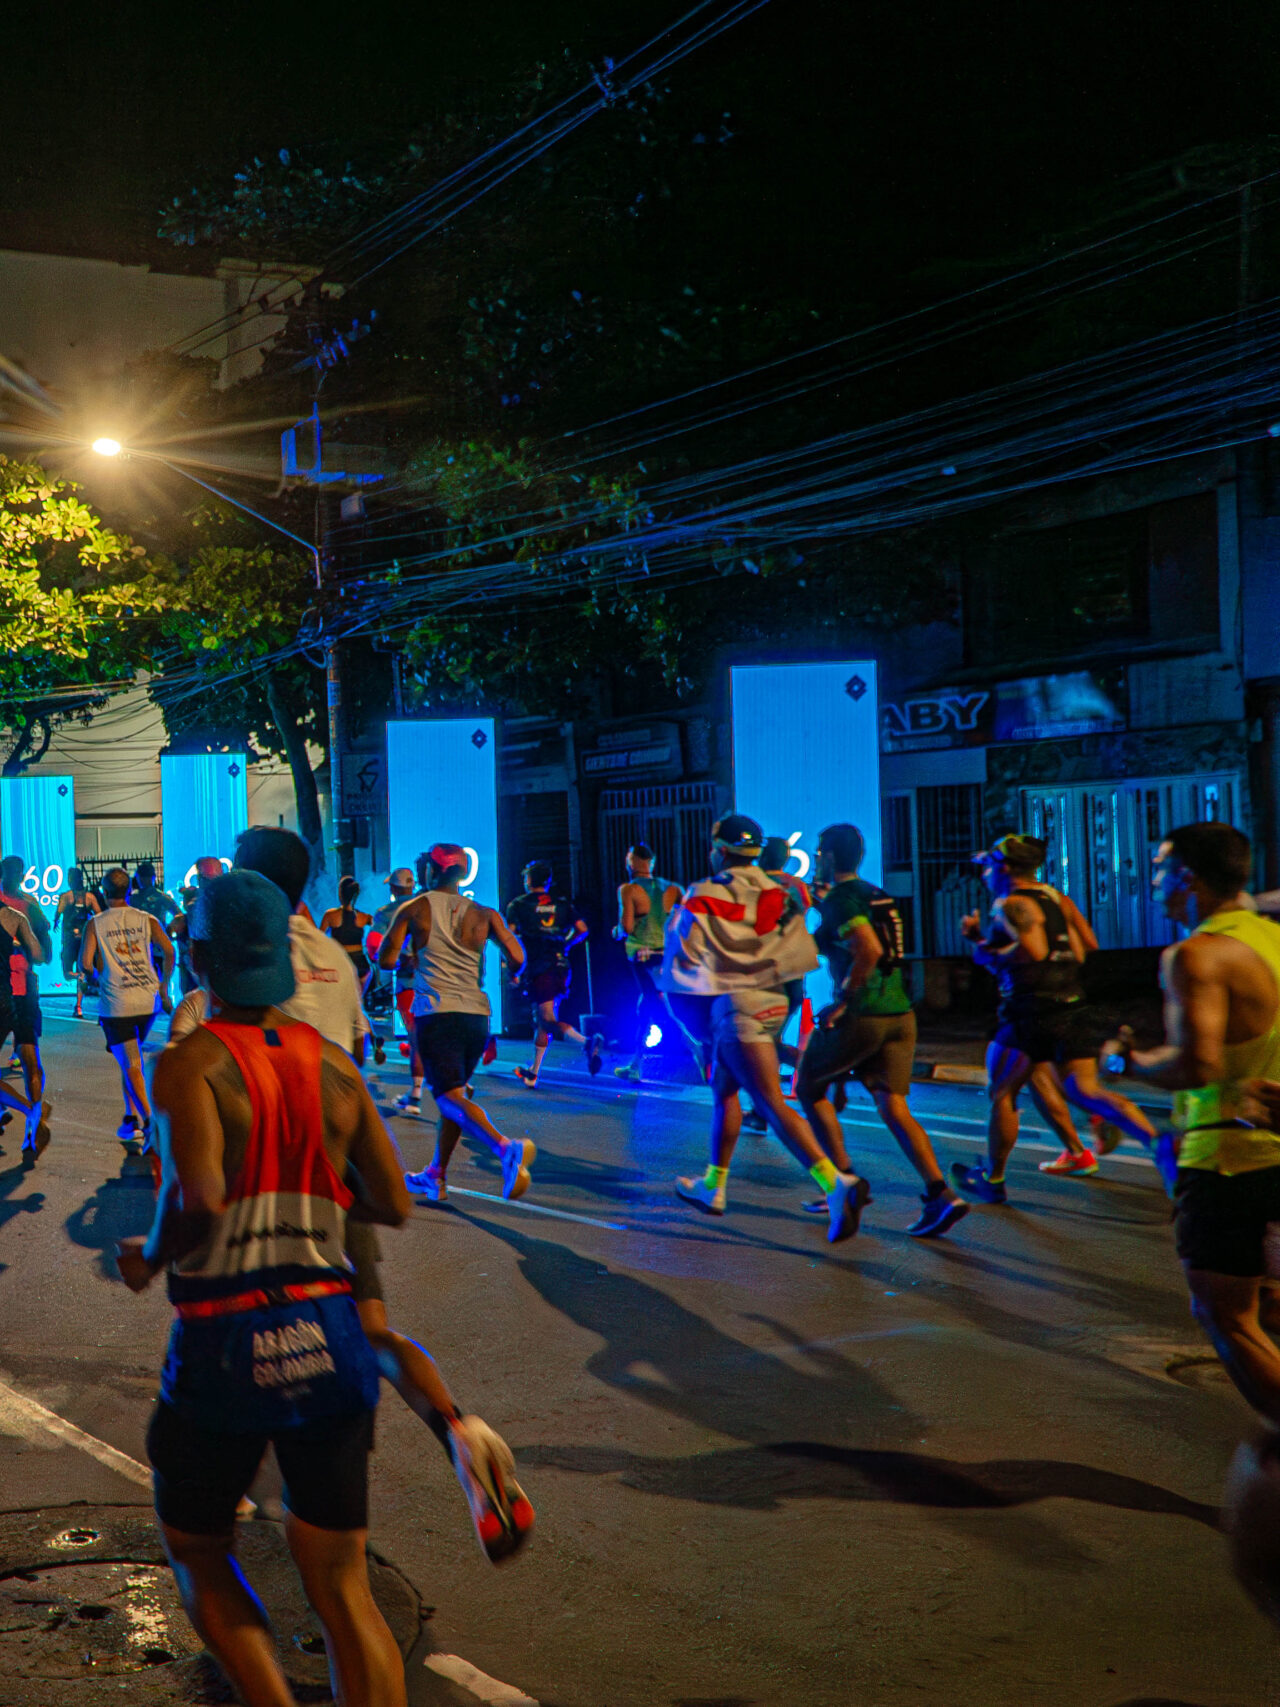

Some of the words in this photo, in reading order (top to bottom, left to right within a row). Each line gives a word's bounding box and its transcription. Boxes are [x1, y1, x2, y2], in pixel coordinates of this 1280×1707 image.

[458, 846, 479, 888] 0
[787, 831, 810, 879] 6
[20, 864, 64, 893] 60
